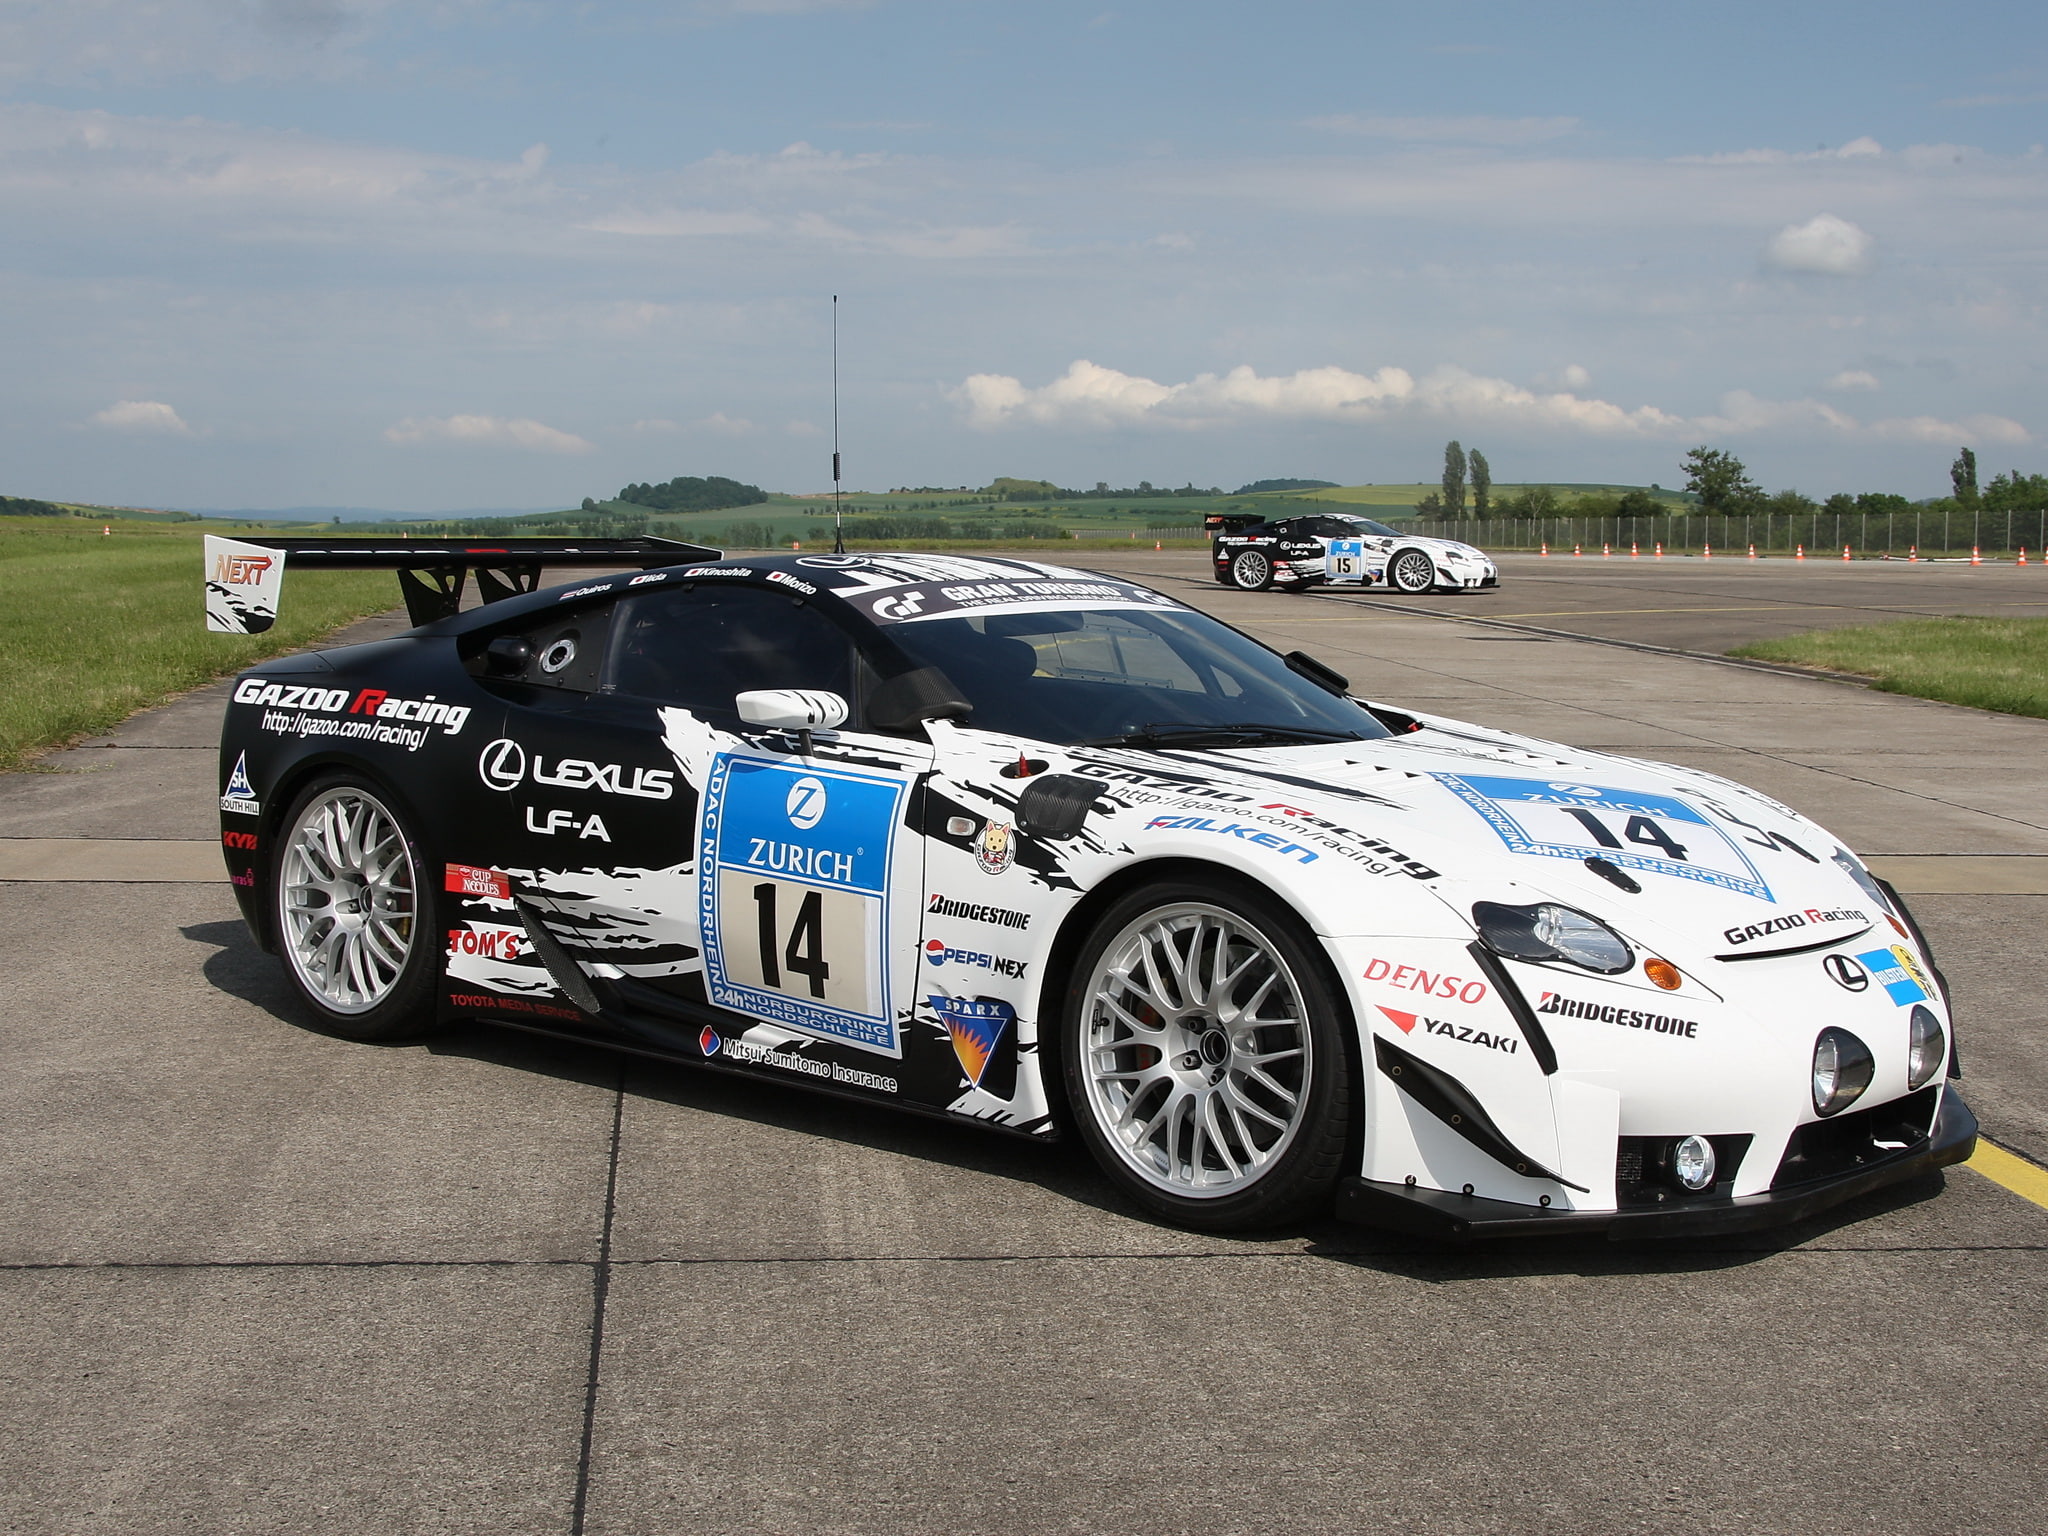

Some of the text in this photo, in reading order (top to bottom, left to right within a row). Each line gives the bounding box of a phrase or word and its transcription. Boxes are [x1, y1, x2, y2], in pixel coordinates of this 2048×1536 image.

[213, 554, 267, 585] NEXT
[780, 575, 817, 595] Morizo
[1337, 557, 1350, 573] 15
[940, 582, 1122, 602] GRAN TURISMO
[233, 678, 471, 735] GAZOO Racing
[261, 709, 430, 752] http://gazoo.com/racing/
[532, 755, 675, 800] LEXUS
[705, 757, 727, 830] ADAC
[221, 799, 259, 814] SOUTH HILL
[526, 806, 612, 843] LF-A
[1071, 763, 1442, 880] GAZOO Racing
[1522, 793, 1669, 818] ZURICH
[1111, 786, 1402, 877] http://gazoo.com/racing/
[1143, 816, 1319, 865] FALKEN
[1558, 807, 1689, 861] 14
[472, 870, 492, 882] CUP
[748, 838, 854, 882] ZURICH
[463, 879, 500, 895] NOODLES
[702, 838, 723, 986] NORDRHEIN
[927, 894, 1031, 931] BRIDGESTONE
[1723, 907, 1870, 946] GAZOO Racing
[448, 929, 518, 960] TOM'S
[753, 882, 830, 1000] 14
[943, 947, 1029, 979] PEPSI NEX
[1362, 958, 1488, 1005] DENSO
[450, 994, 497, 1007] TOYOTA
[714, 986, 889, 1037] 24h NÜRBURGRING
[945, 1000, 1001, 1017] SPARX
[1537, 992, 1698, 1039] BRIDGESTONE
[744, 1001, 890, 1047] NORDSCHLEIFE
[1422, 1016, 1518, 1055] YAZAKI
[723, 1037, 898, 1093] Mitsui Sumitomo Insurance
